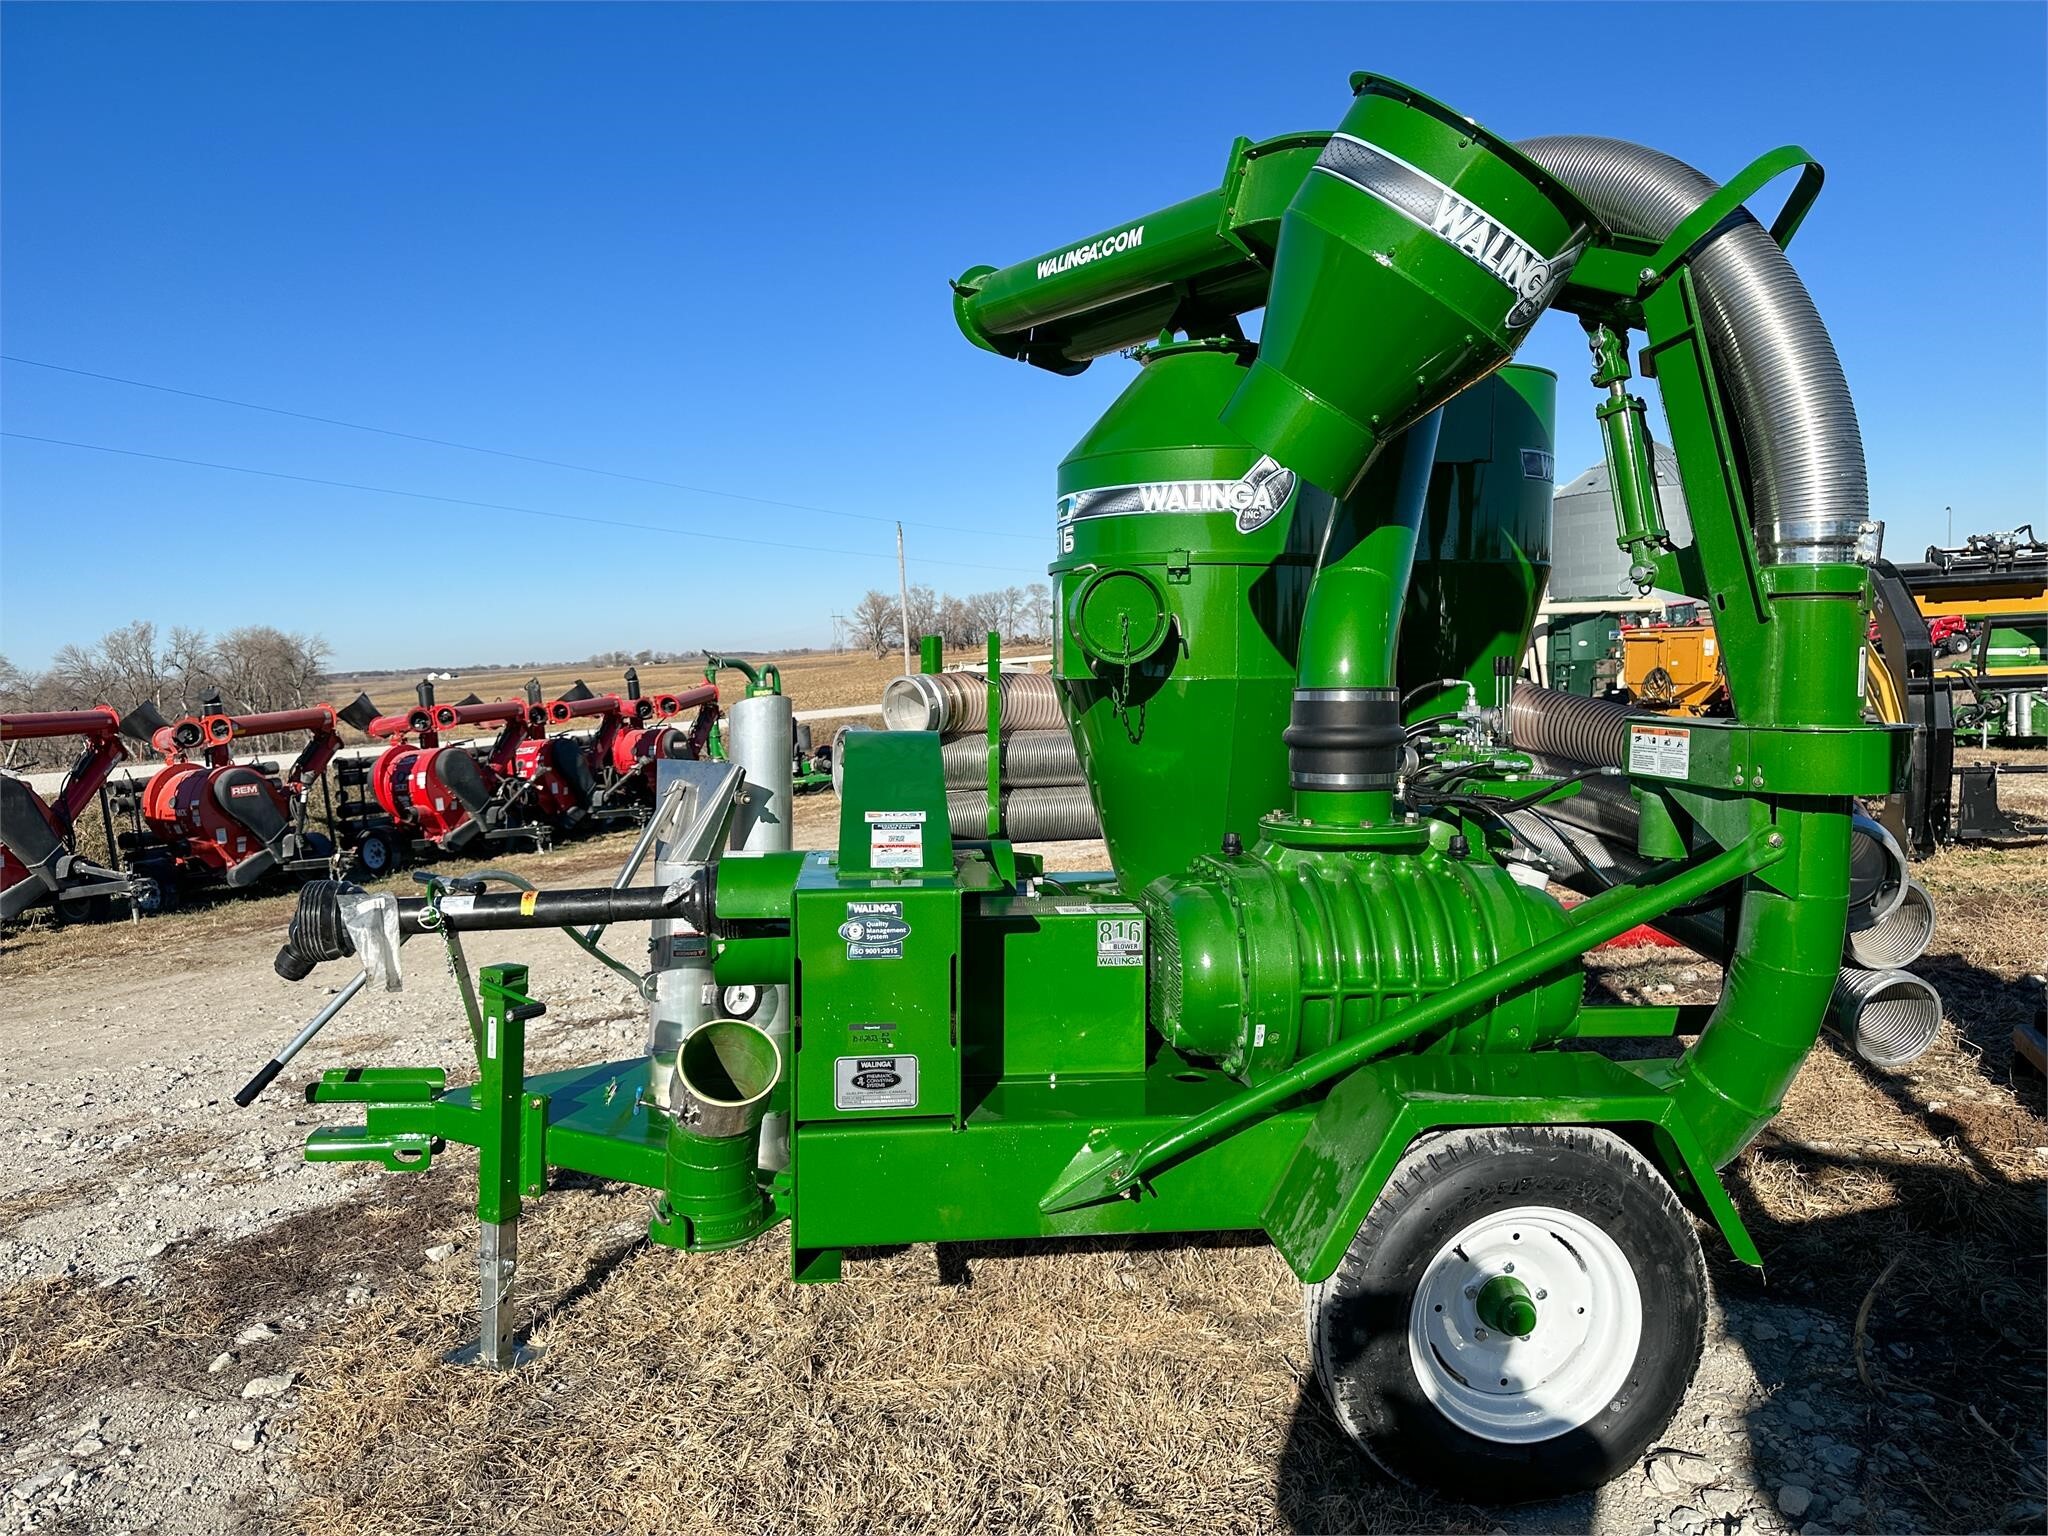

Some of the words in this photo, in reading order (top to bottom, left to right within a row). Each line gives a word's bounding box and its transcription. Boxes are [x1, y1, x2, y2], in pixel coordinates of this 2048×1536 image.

[1140, 483, 1275, 512] WALINGA
[232, 785, 258, 795] REM
[853, 903, 898, 913] WALINGA
[866, 927, 907, 935] Management
[1100, 921, 1141, 943] 816
[1099, 957, 1141, 965] WALINGA
